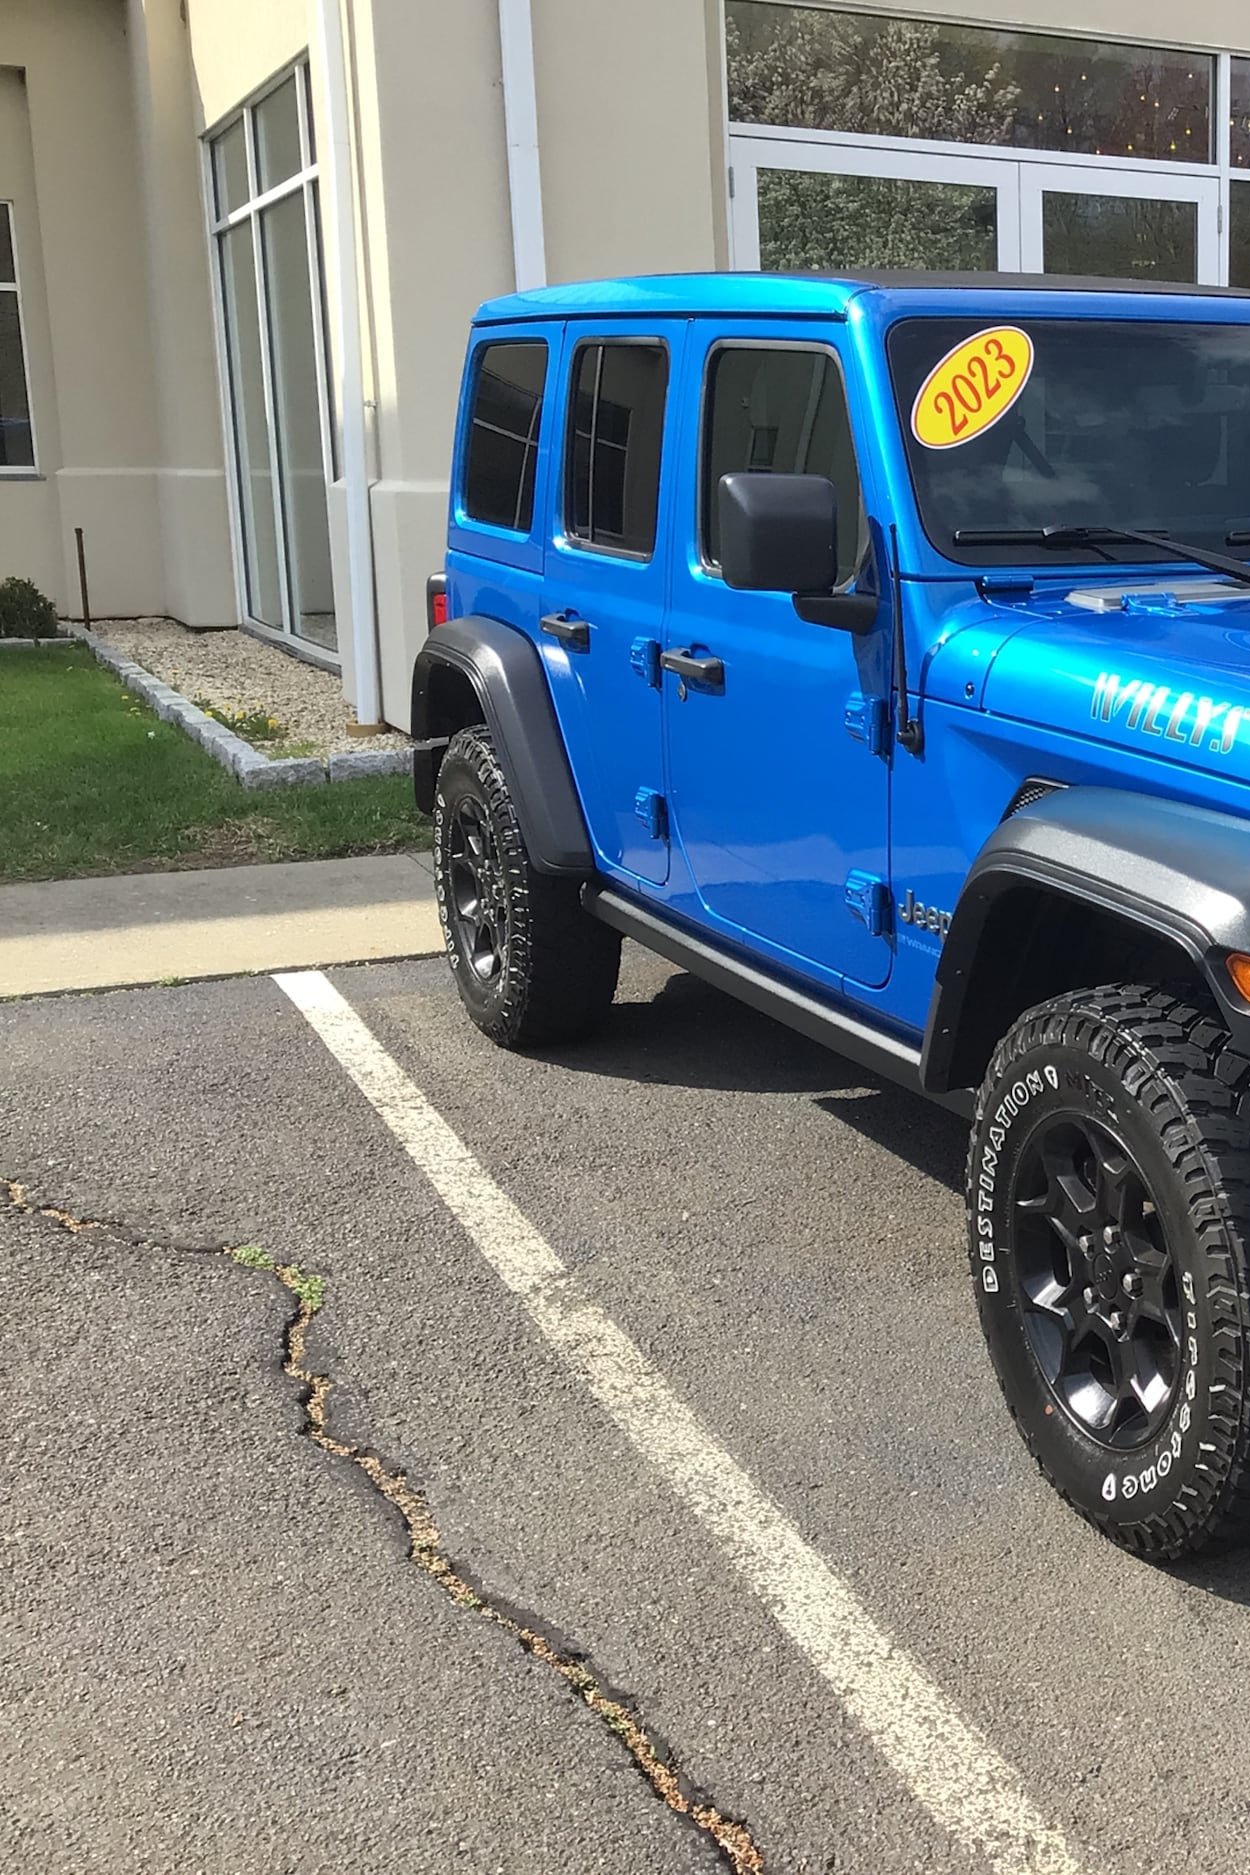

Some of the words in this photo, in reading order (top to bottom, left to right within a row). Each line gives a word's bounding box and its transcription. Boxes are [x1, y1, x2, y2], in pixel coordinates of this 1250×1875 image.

[934, 338, 1016, 436] 2023
[898, 888, 953, 945] Jeep
[976, 1069, 1045, 1293] DESTINATION
